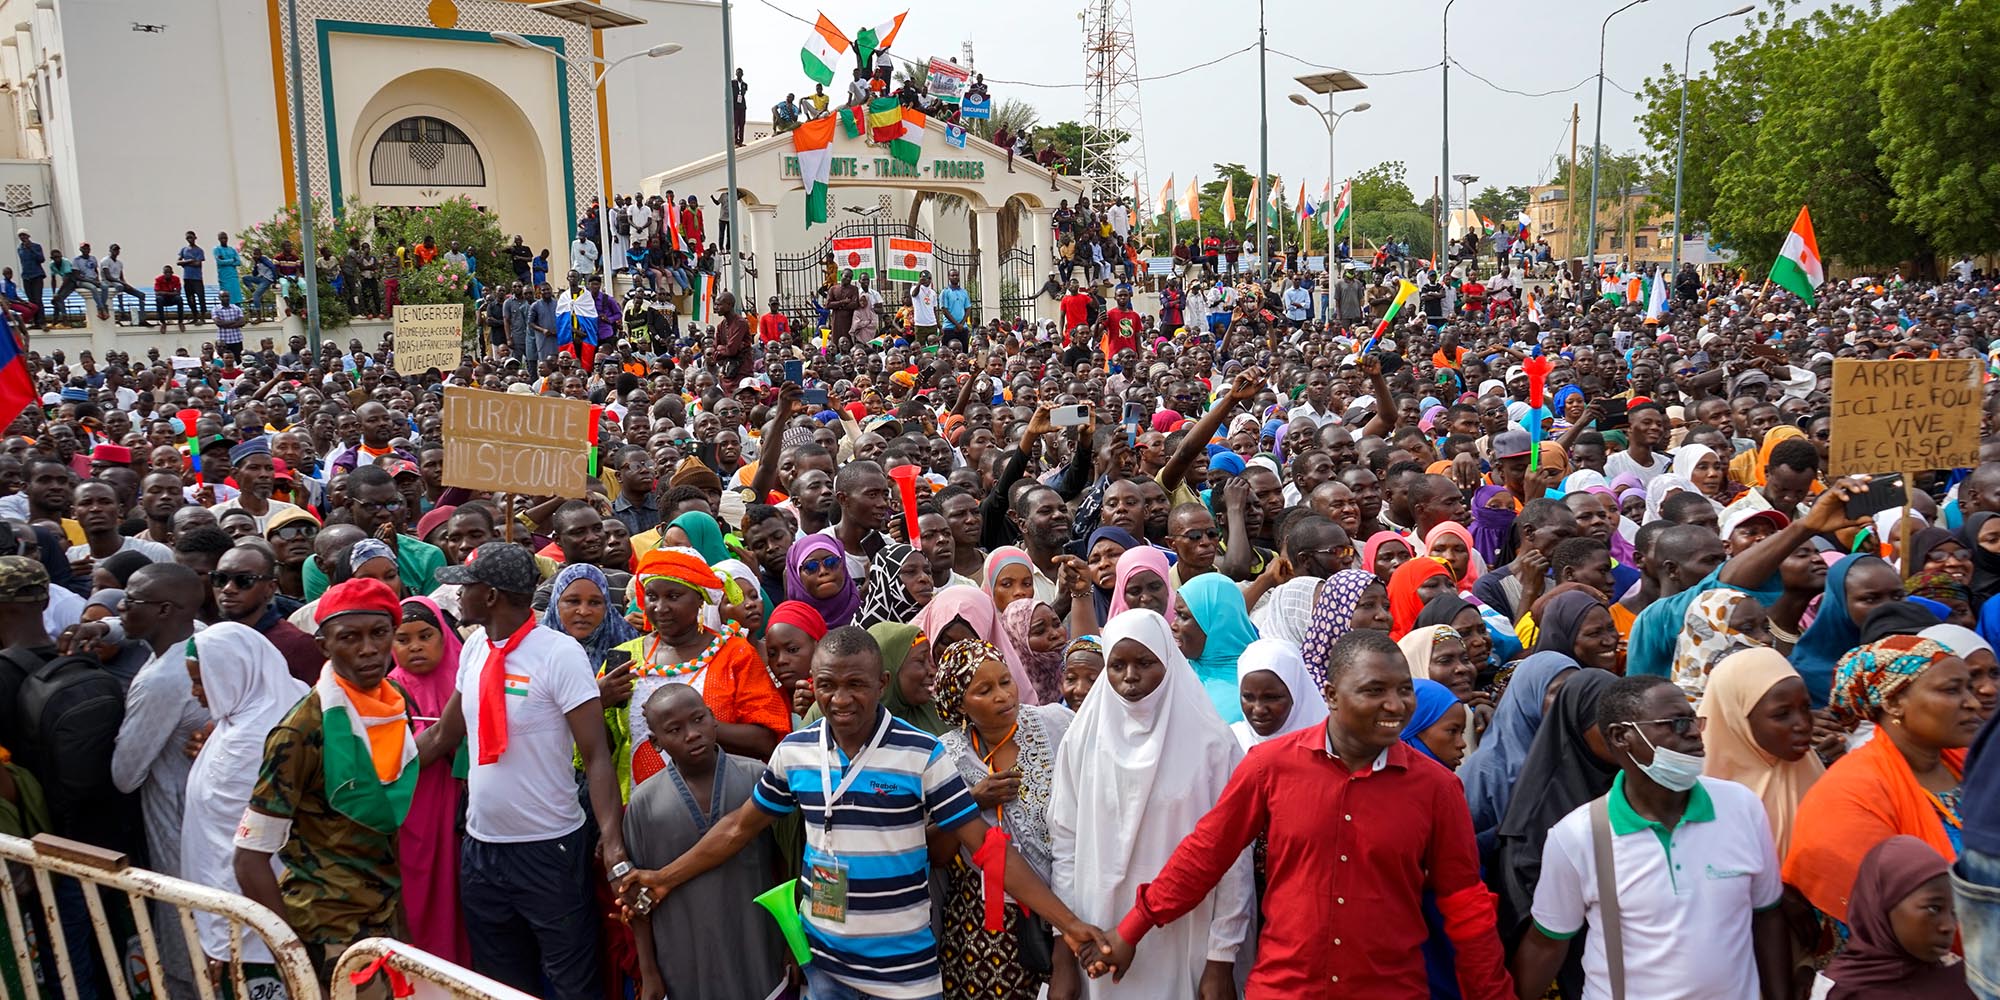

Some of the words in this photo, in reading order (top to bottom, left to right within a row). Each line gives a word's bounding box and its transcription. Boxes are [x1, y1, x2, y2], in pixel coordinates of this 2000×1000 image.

[933, 160, 985, 180] PROGRES
[1850, 362, 1977, 388] ARRETEZ
[444, 395, 581, 441] TURQUIE
[477, 442, 588, 490] SECOURS
